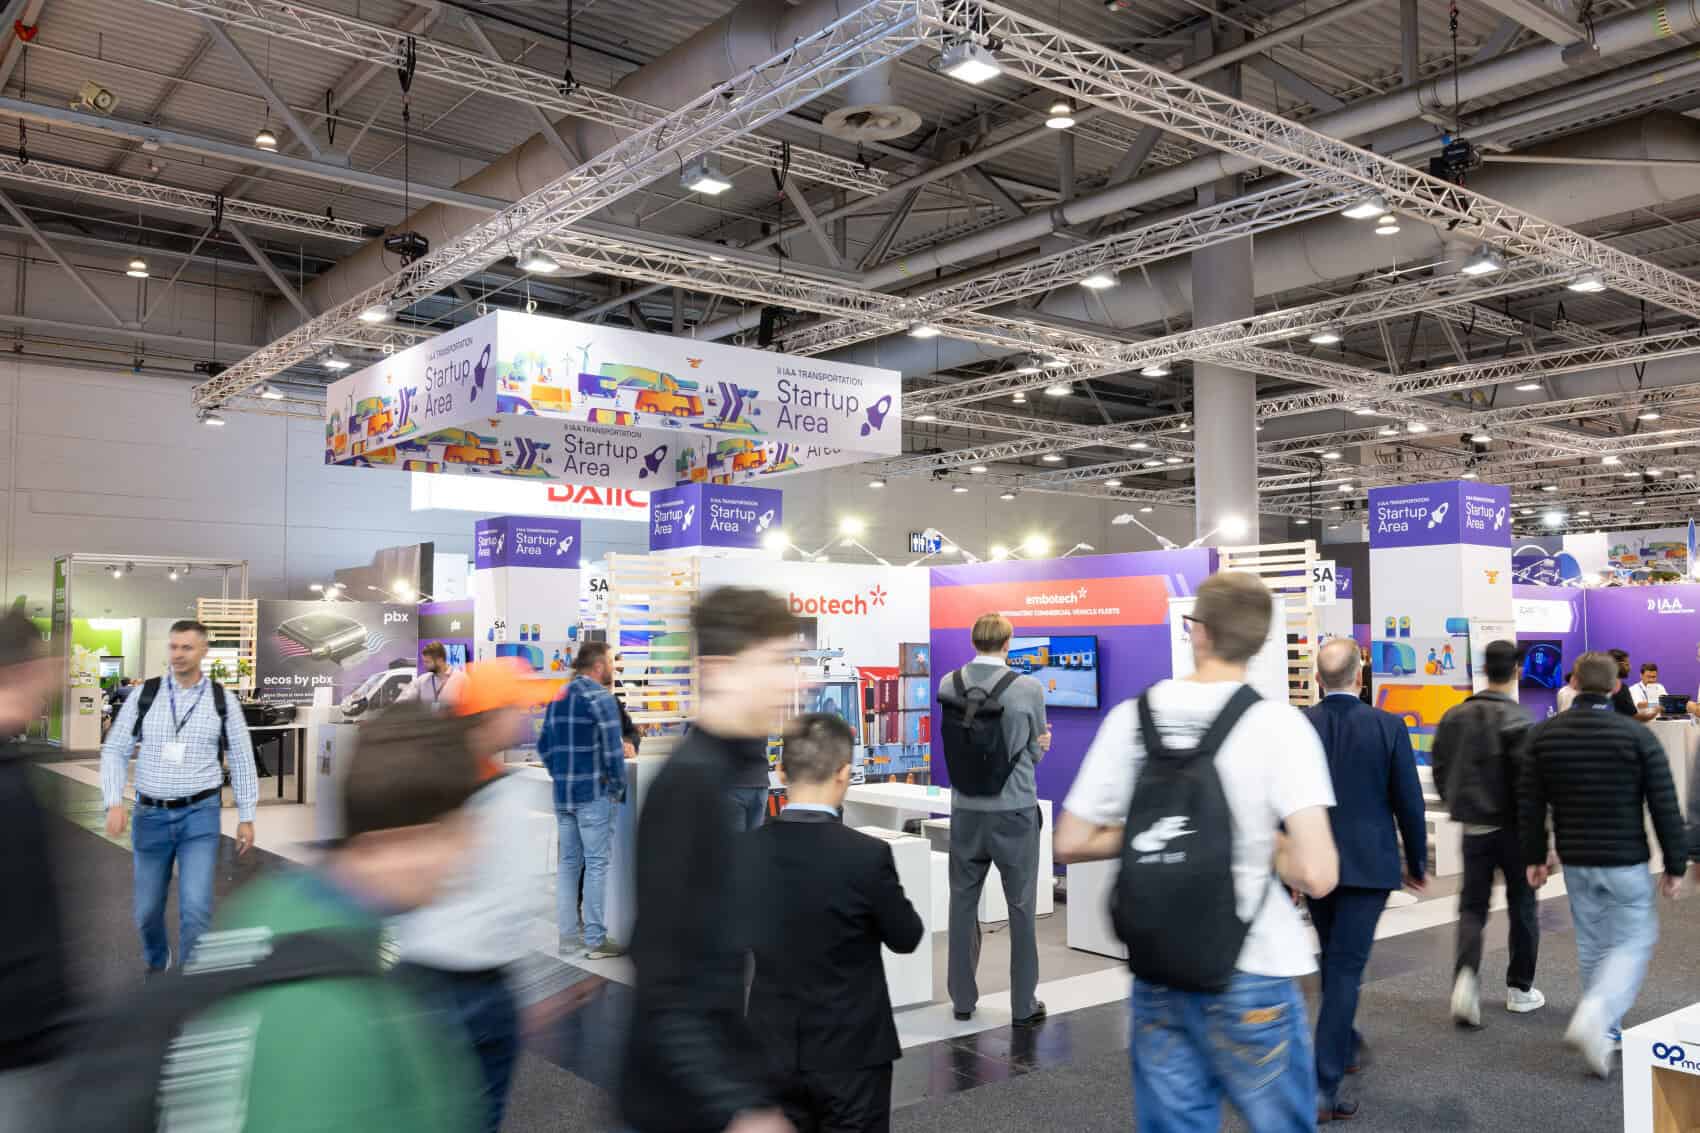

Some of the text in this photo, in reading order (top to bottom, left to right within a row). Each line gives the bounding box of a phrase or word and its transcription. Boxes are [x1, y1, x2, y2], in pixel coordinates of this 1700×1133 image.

[425, 360, 470, 391] Startup
[798, 370, 863, 386] TRANSPORTATION
[425, 393, 452, 418] Area
[777, 379, 859, 417] Startup
[777, 405, 828, 433] Area
[564, 433, 638, 464] Startup
[563, 454, 610, 477] Area
[654, 509, 683, 523] Startup
[710, 503, 756, 523] Startup
[1378, 506, 1428, 520] Startup
[1465, 502, 1495, 518] Startup
[654, 523, 673, 536] Area
[710, 518, 739, 532] Area
[1378, 520, 1409, 533] Area
[1465, 516, 1485, 530] Area
[516, 532, 558, 548] Startup
[516, 544, 542, 555] Area
[1312, 567, 1334, 583] SA
[590, 578, 609, 592] SA
[789, 591, 868, 616] botech
[1025, 593, 1079, 605] embotech
[1657, 598, 1682, 609] IAA
[383, 610, 409, 625] pbx
[263, 674, 333, 687] ecos by pbx
